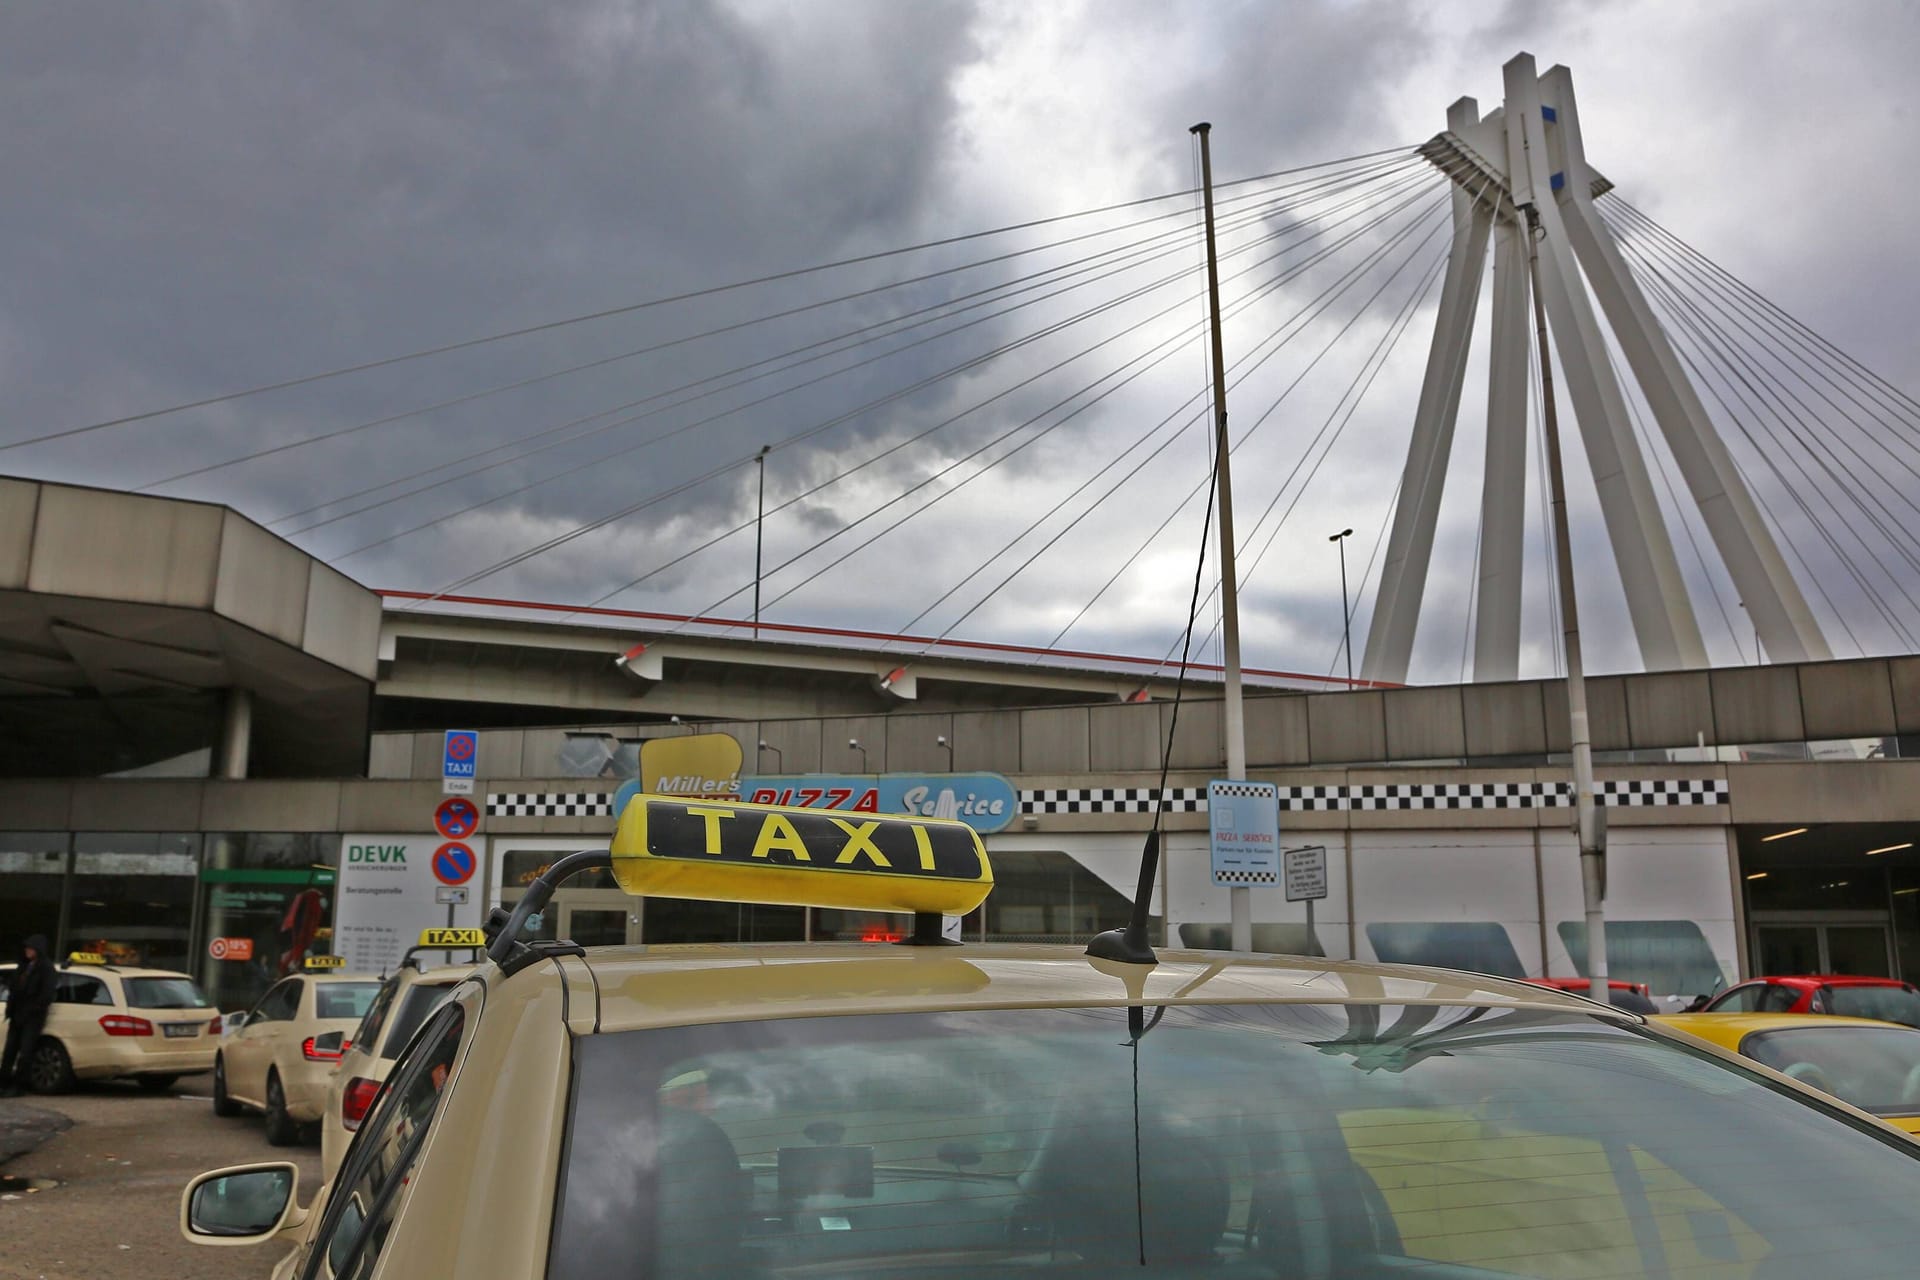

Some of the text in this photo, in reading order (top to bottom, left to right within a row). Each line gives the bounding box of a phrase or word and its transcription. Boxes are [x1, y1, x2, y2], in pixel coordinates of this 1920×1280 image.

[447, 762, 473, 774] TAXI
[655, 772, 742, 793] Miller's
[751, 787, 879, 813] PIZZA
[686, 806, 937, 871] TAXI
[1215, 831, 1273, 843] PIZZA SERVICE
[348, 845, 407, 863] DEVK
[429, 930, 476, 943] TAXI
